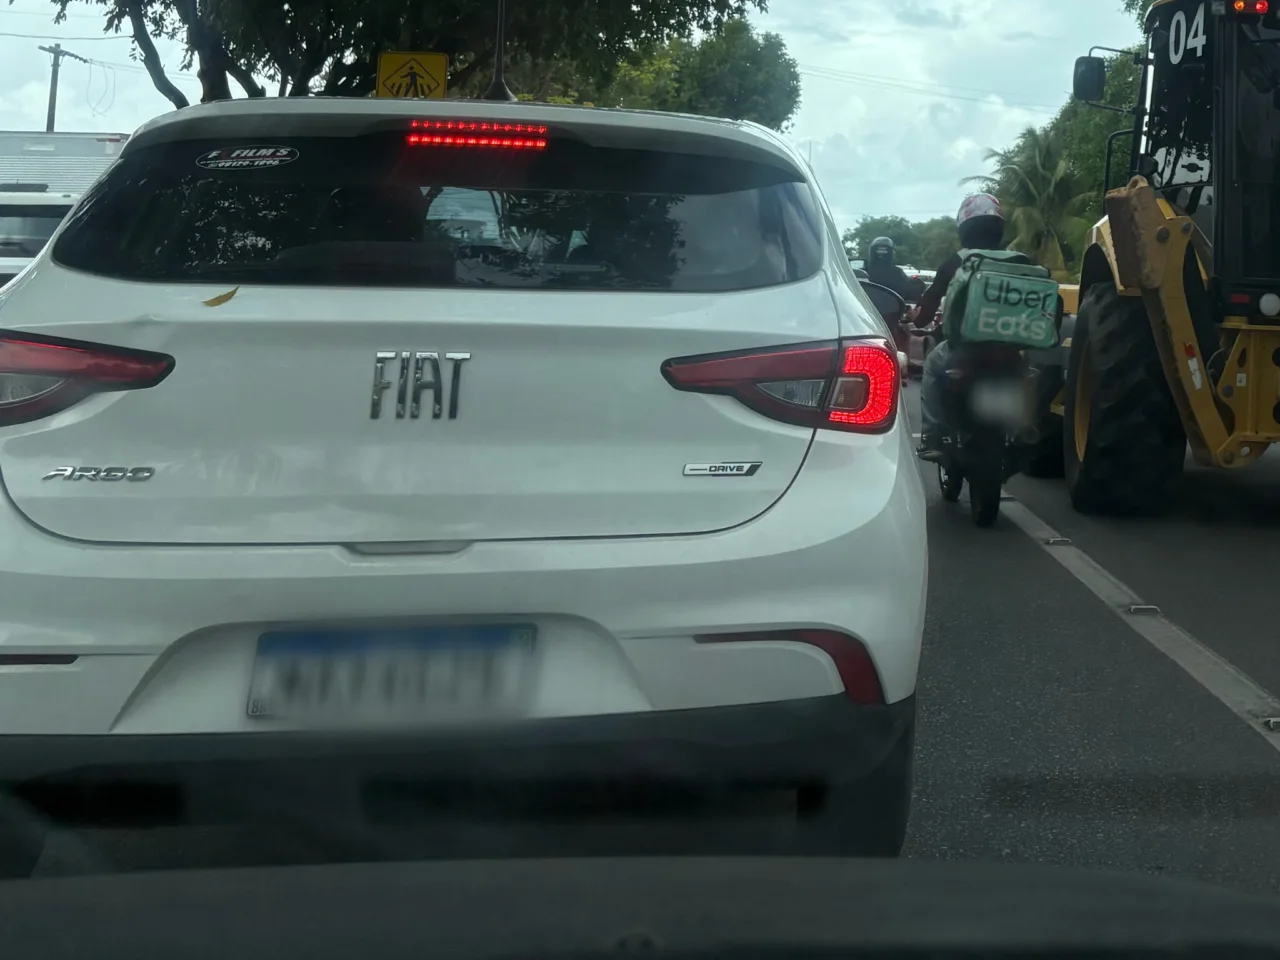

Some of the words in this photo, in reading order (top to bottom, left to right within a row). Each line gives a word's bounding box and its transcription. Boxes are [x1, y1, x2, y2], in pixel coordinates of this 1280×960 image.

[1169, 3, 1206, 64] 04
[984, 277, 1053, 311] Uber
[979, 308, 1046, 340] Eats
[370, 351, 471, 420] FIAT
[42, 466, 155, 482] ARGO
